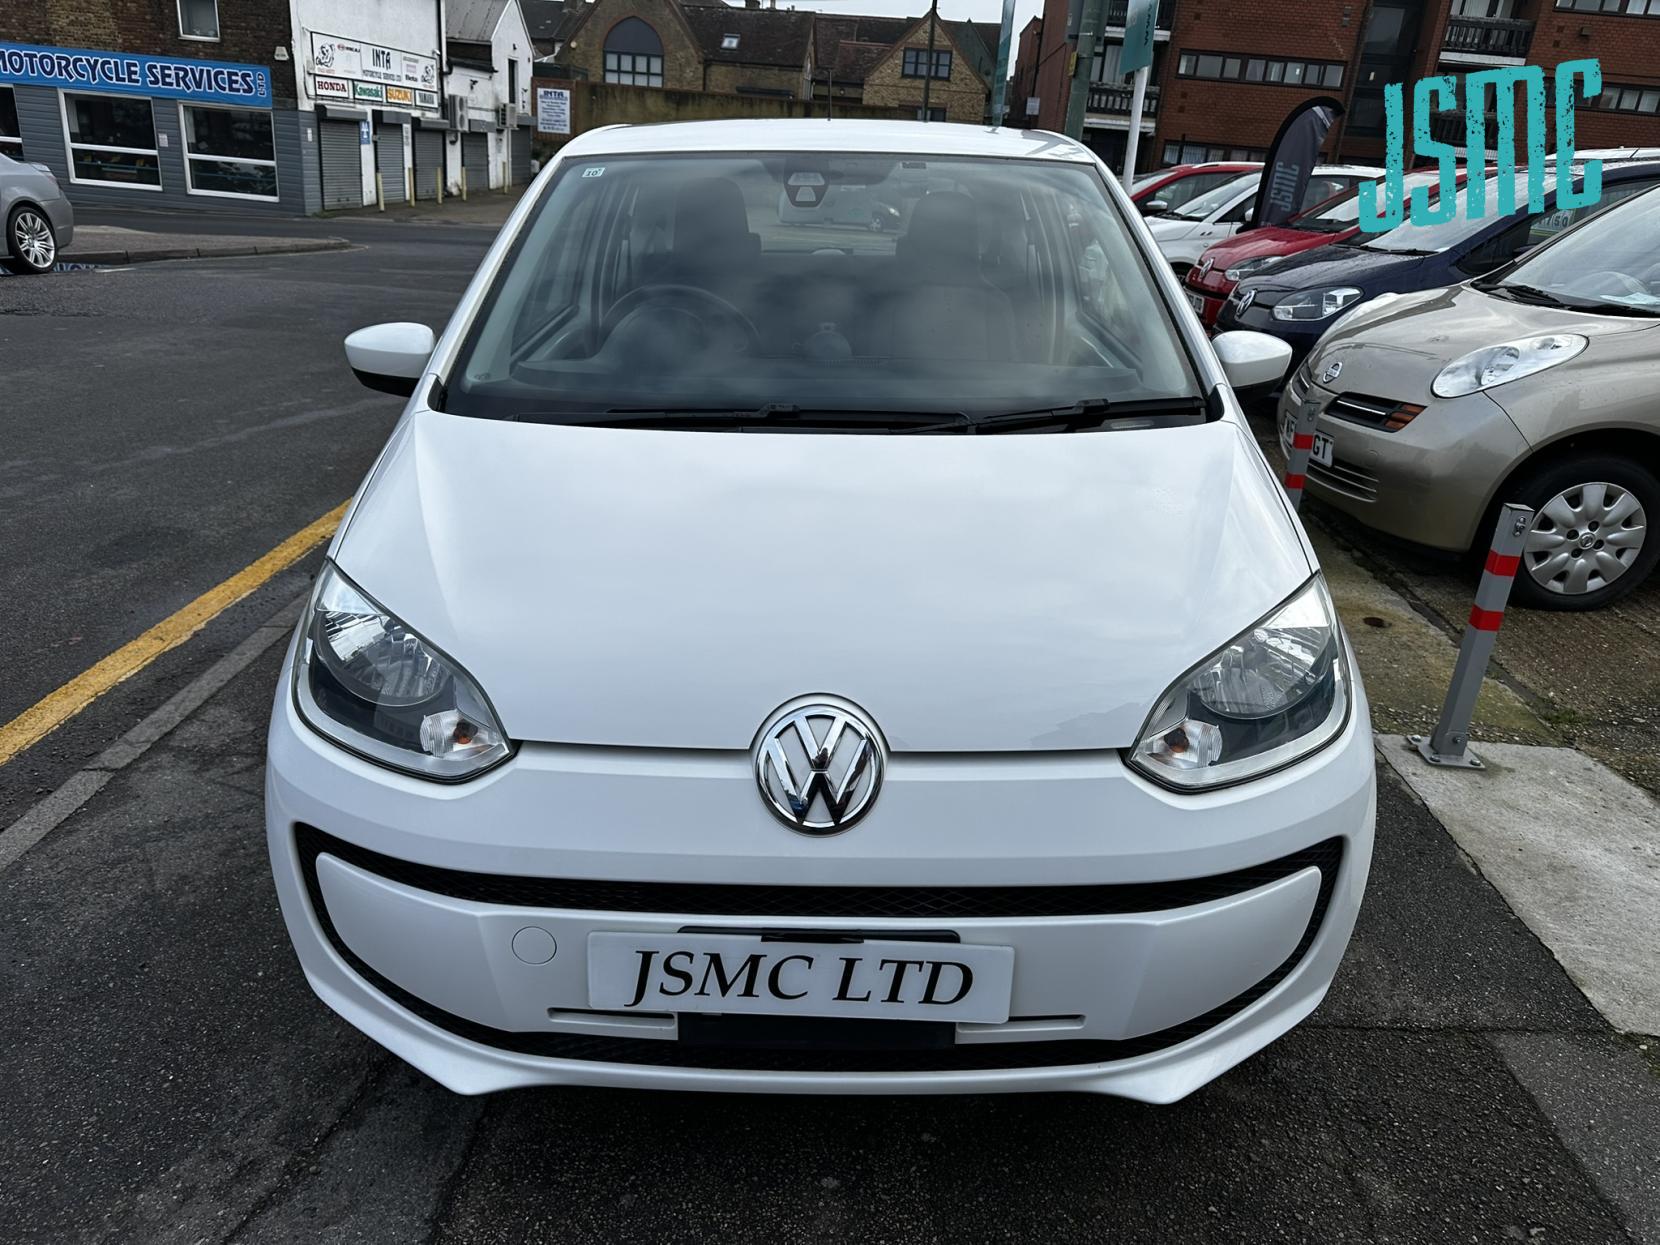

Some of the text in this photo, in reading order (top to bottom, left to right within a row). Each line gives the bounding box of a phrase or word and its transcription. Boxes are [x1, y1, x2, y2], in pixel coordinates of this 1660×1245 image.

[372, 48, 392, 70] INTA
[147, 62, 255, 97] SERVICES
[256, 71, 267, 98] LTD
[317, 80, 347, 93] HONDA
[354, 83, 383, 98] Kawasaki
[387, 88, 412, 102] SUZUKI
[1270, 161, 1300, 212] JSMC
[624, 949, 974, 1008] JSMC LTD
